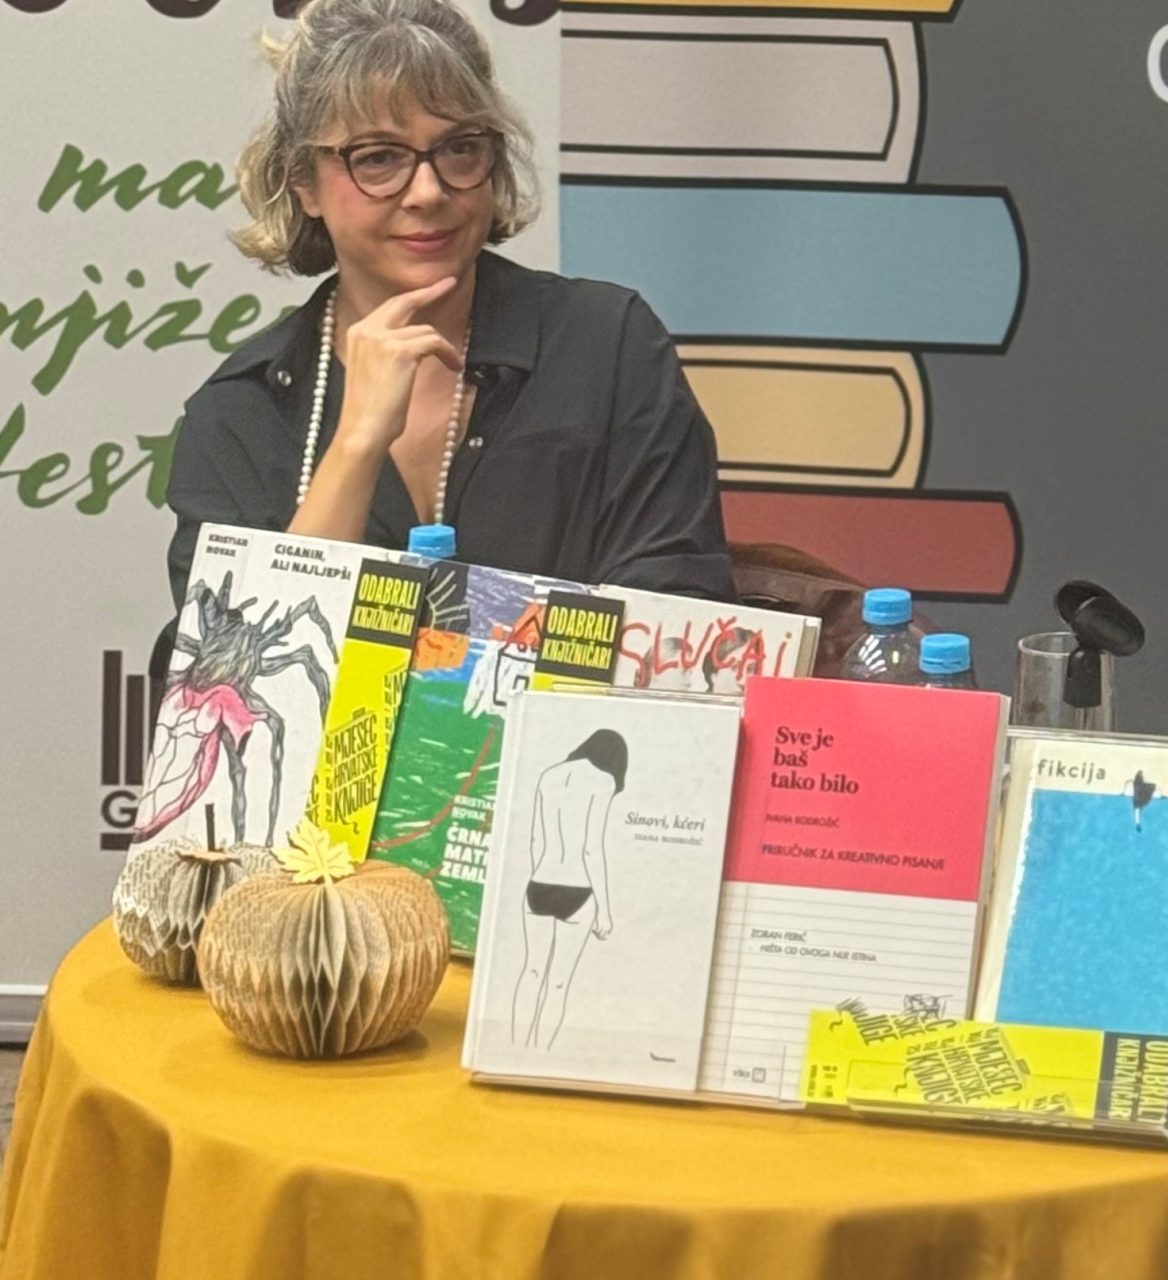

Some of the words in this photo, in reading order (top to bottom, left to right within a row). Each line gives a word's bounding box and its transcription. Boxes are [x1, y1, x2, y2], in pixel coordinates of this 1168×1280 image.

[37, 143, 240, 214] ma
[0, 261, 300, 397] njiže
[206, 546, 237, 558] NOVAK
[208, 533, 249, 547] KRISTIAN
[274, 543, 327, 563] CIGANIN,
[270, 559, 291, 571] ALI
[292, 561, 352, 581] NAJLJEPŠI
[358, 573, 422, 610] ODABRALI
[352, 605, 415, 637] KNJIŽNIČARI
[547, 605, 618, 643] ODABRALI
[540, 638, 613, 670] KNJIŽNIČARI
[334, 713, 377, 766] MJESEC
[775, 725, 812, 747] Sve
[812, 728, 834, 751] je
[333, 744, 377, 788] HRVATSKE
[773, 747, 808, 768] baš
[771, 770, 815, 791] tako
[820, 772, 859, 795] bilo
[1037, 759, 1107, 784] fikcija
[333, 769, 377, 826] KNJIGE
[453, 794, 495, 810] KRISTIA
[624, 811, 669, 830] Sinovi,
[673, 814, 706, 832] kćeri
[765, 813, 793, 825] IVANA
[762, 843, 818, 859] PRIRUČNIK
[820, 848, 836, 861] ZA
[838, 851, 901, 866] KREATIVNO
[902, 855, 946, 871] PISANJE
[440, 860, 486, 885] ZEML
[941, 1044, 991, 1105] HRVATSKE
[969, 1035, 1025, 1097] MJESEC
